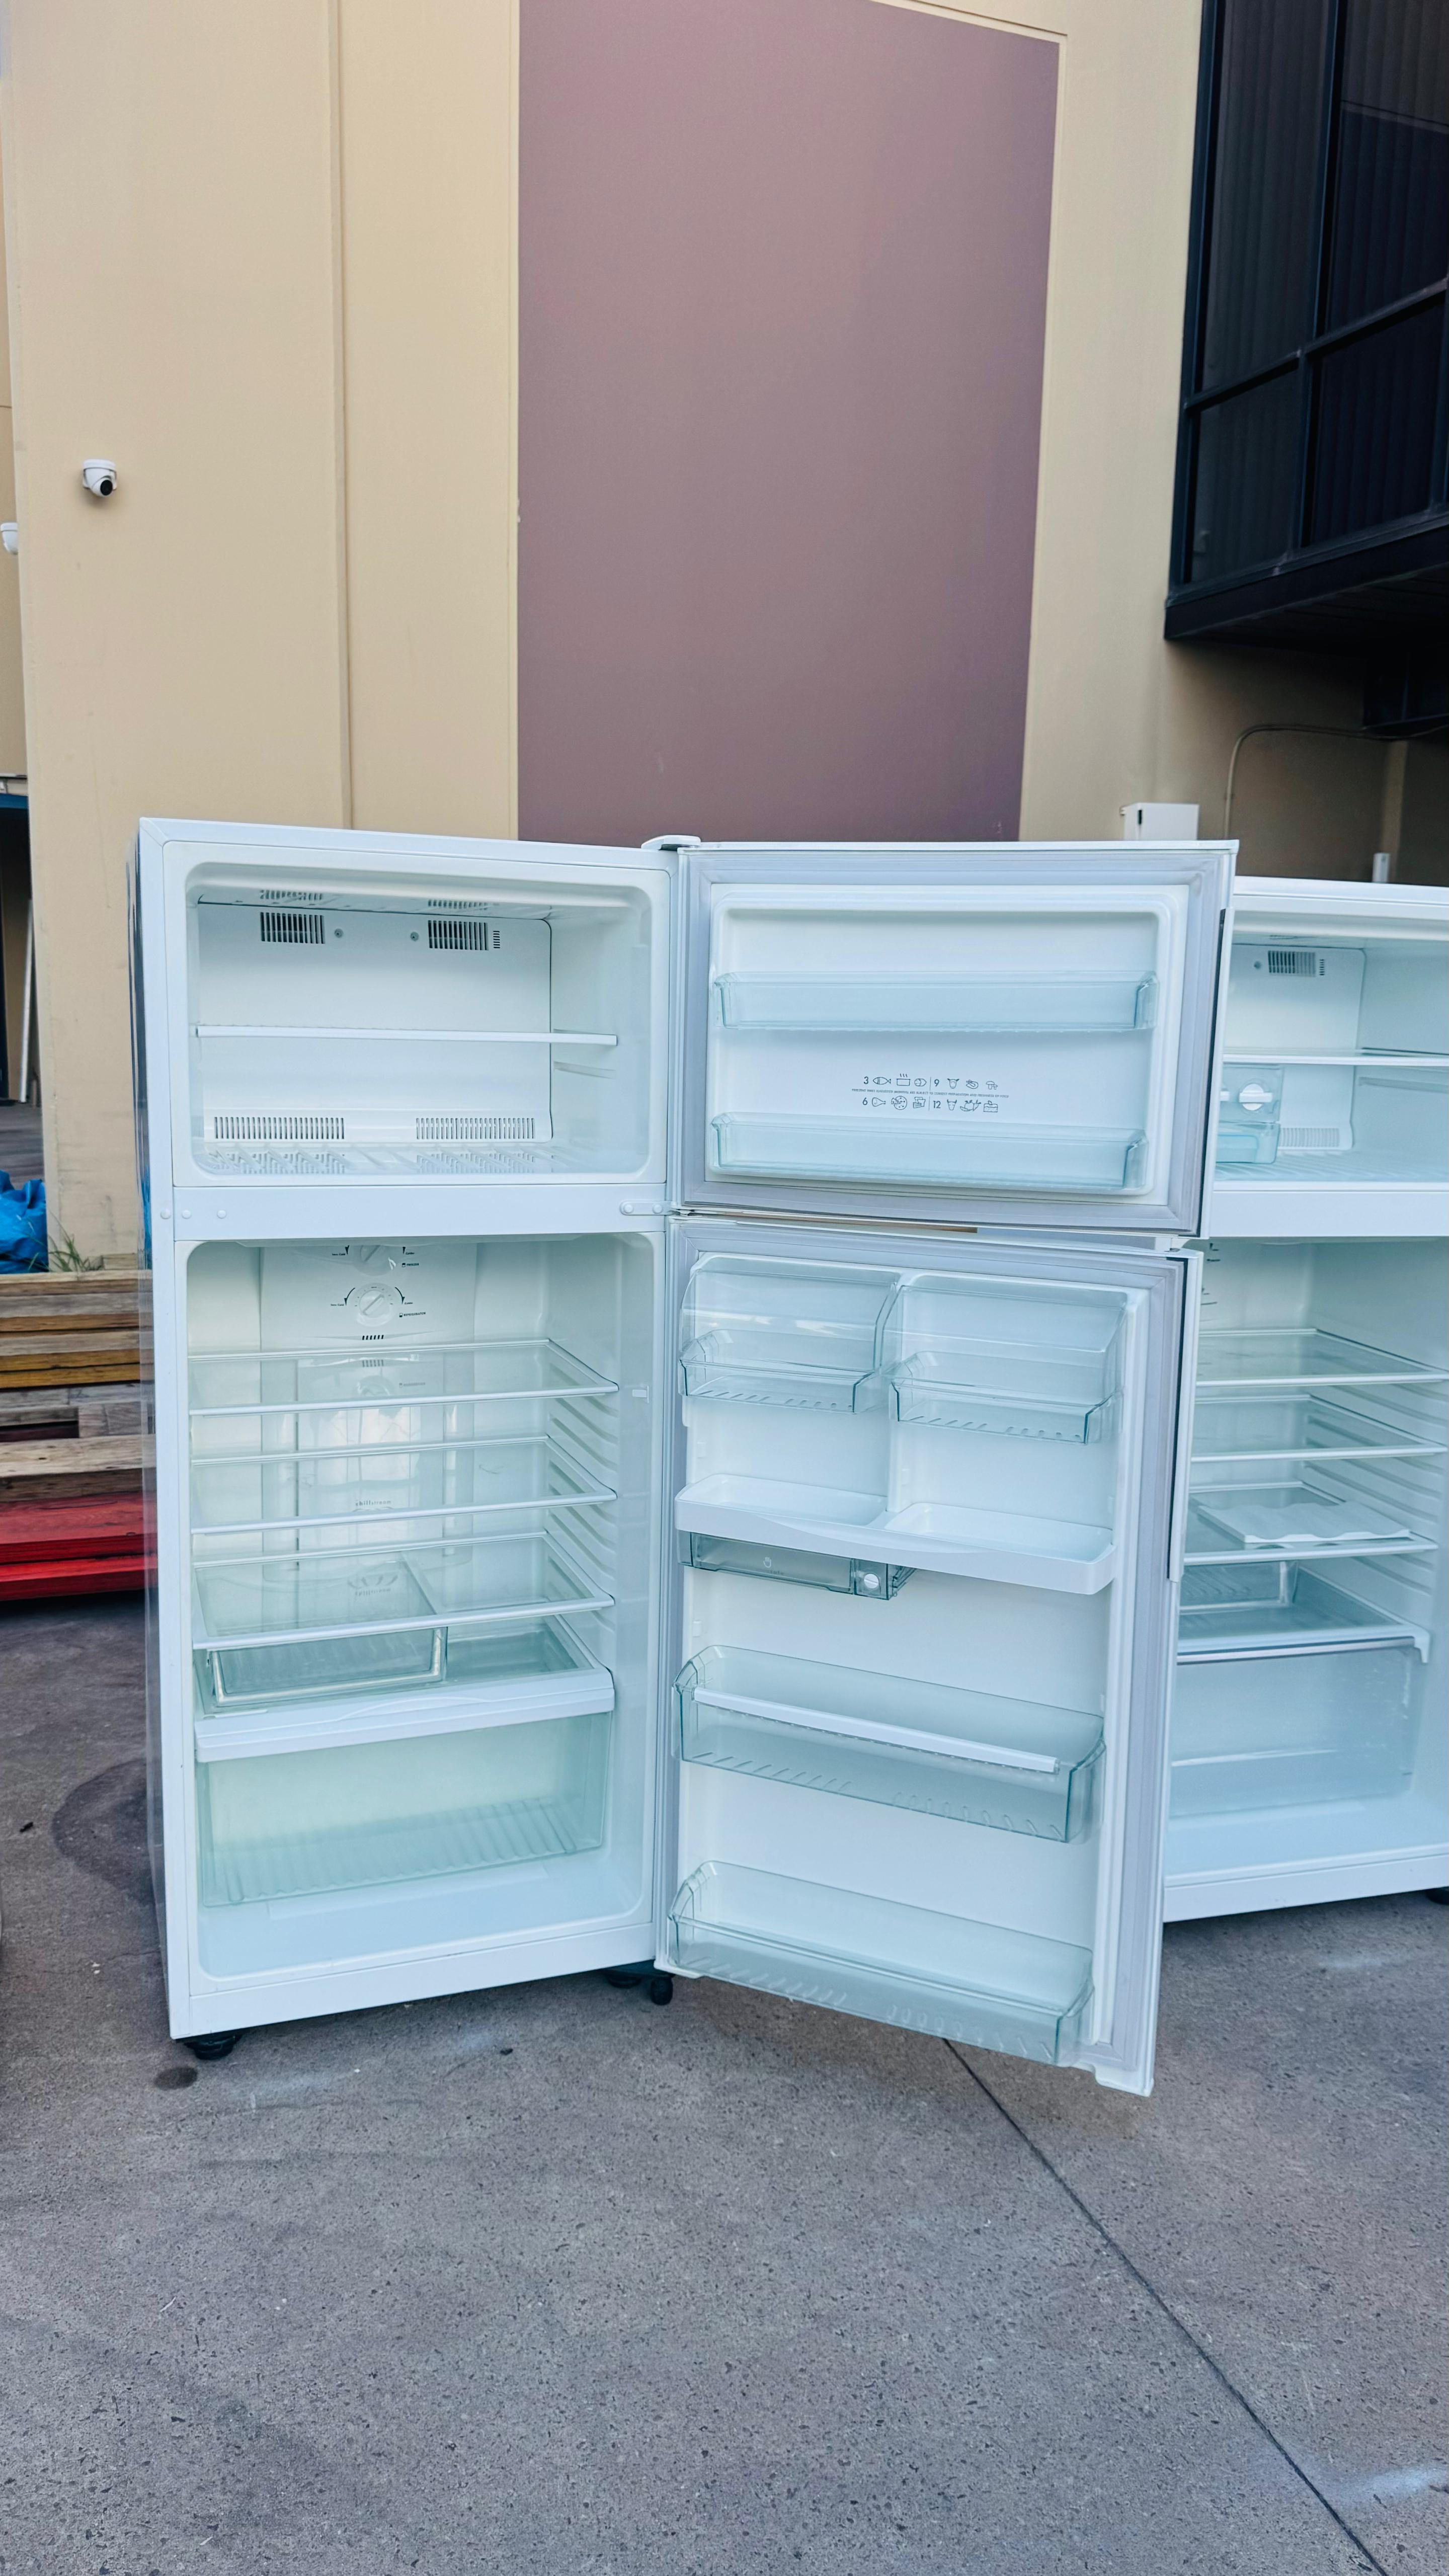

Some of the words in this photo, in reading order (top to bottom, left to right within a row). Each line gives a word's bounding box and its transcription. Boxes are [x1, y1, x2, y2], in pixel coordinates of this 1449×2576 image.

[863, 1076, 869, 1085] 3
[934, 1079, 940, 1087] 9
[862, 1097, 868, 1105] 6
[933, 1100, 941, 1108] 12
